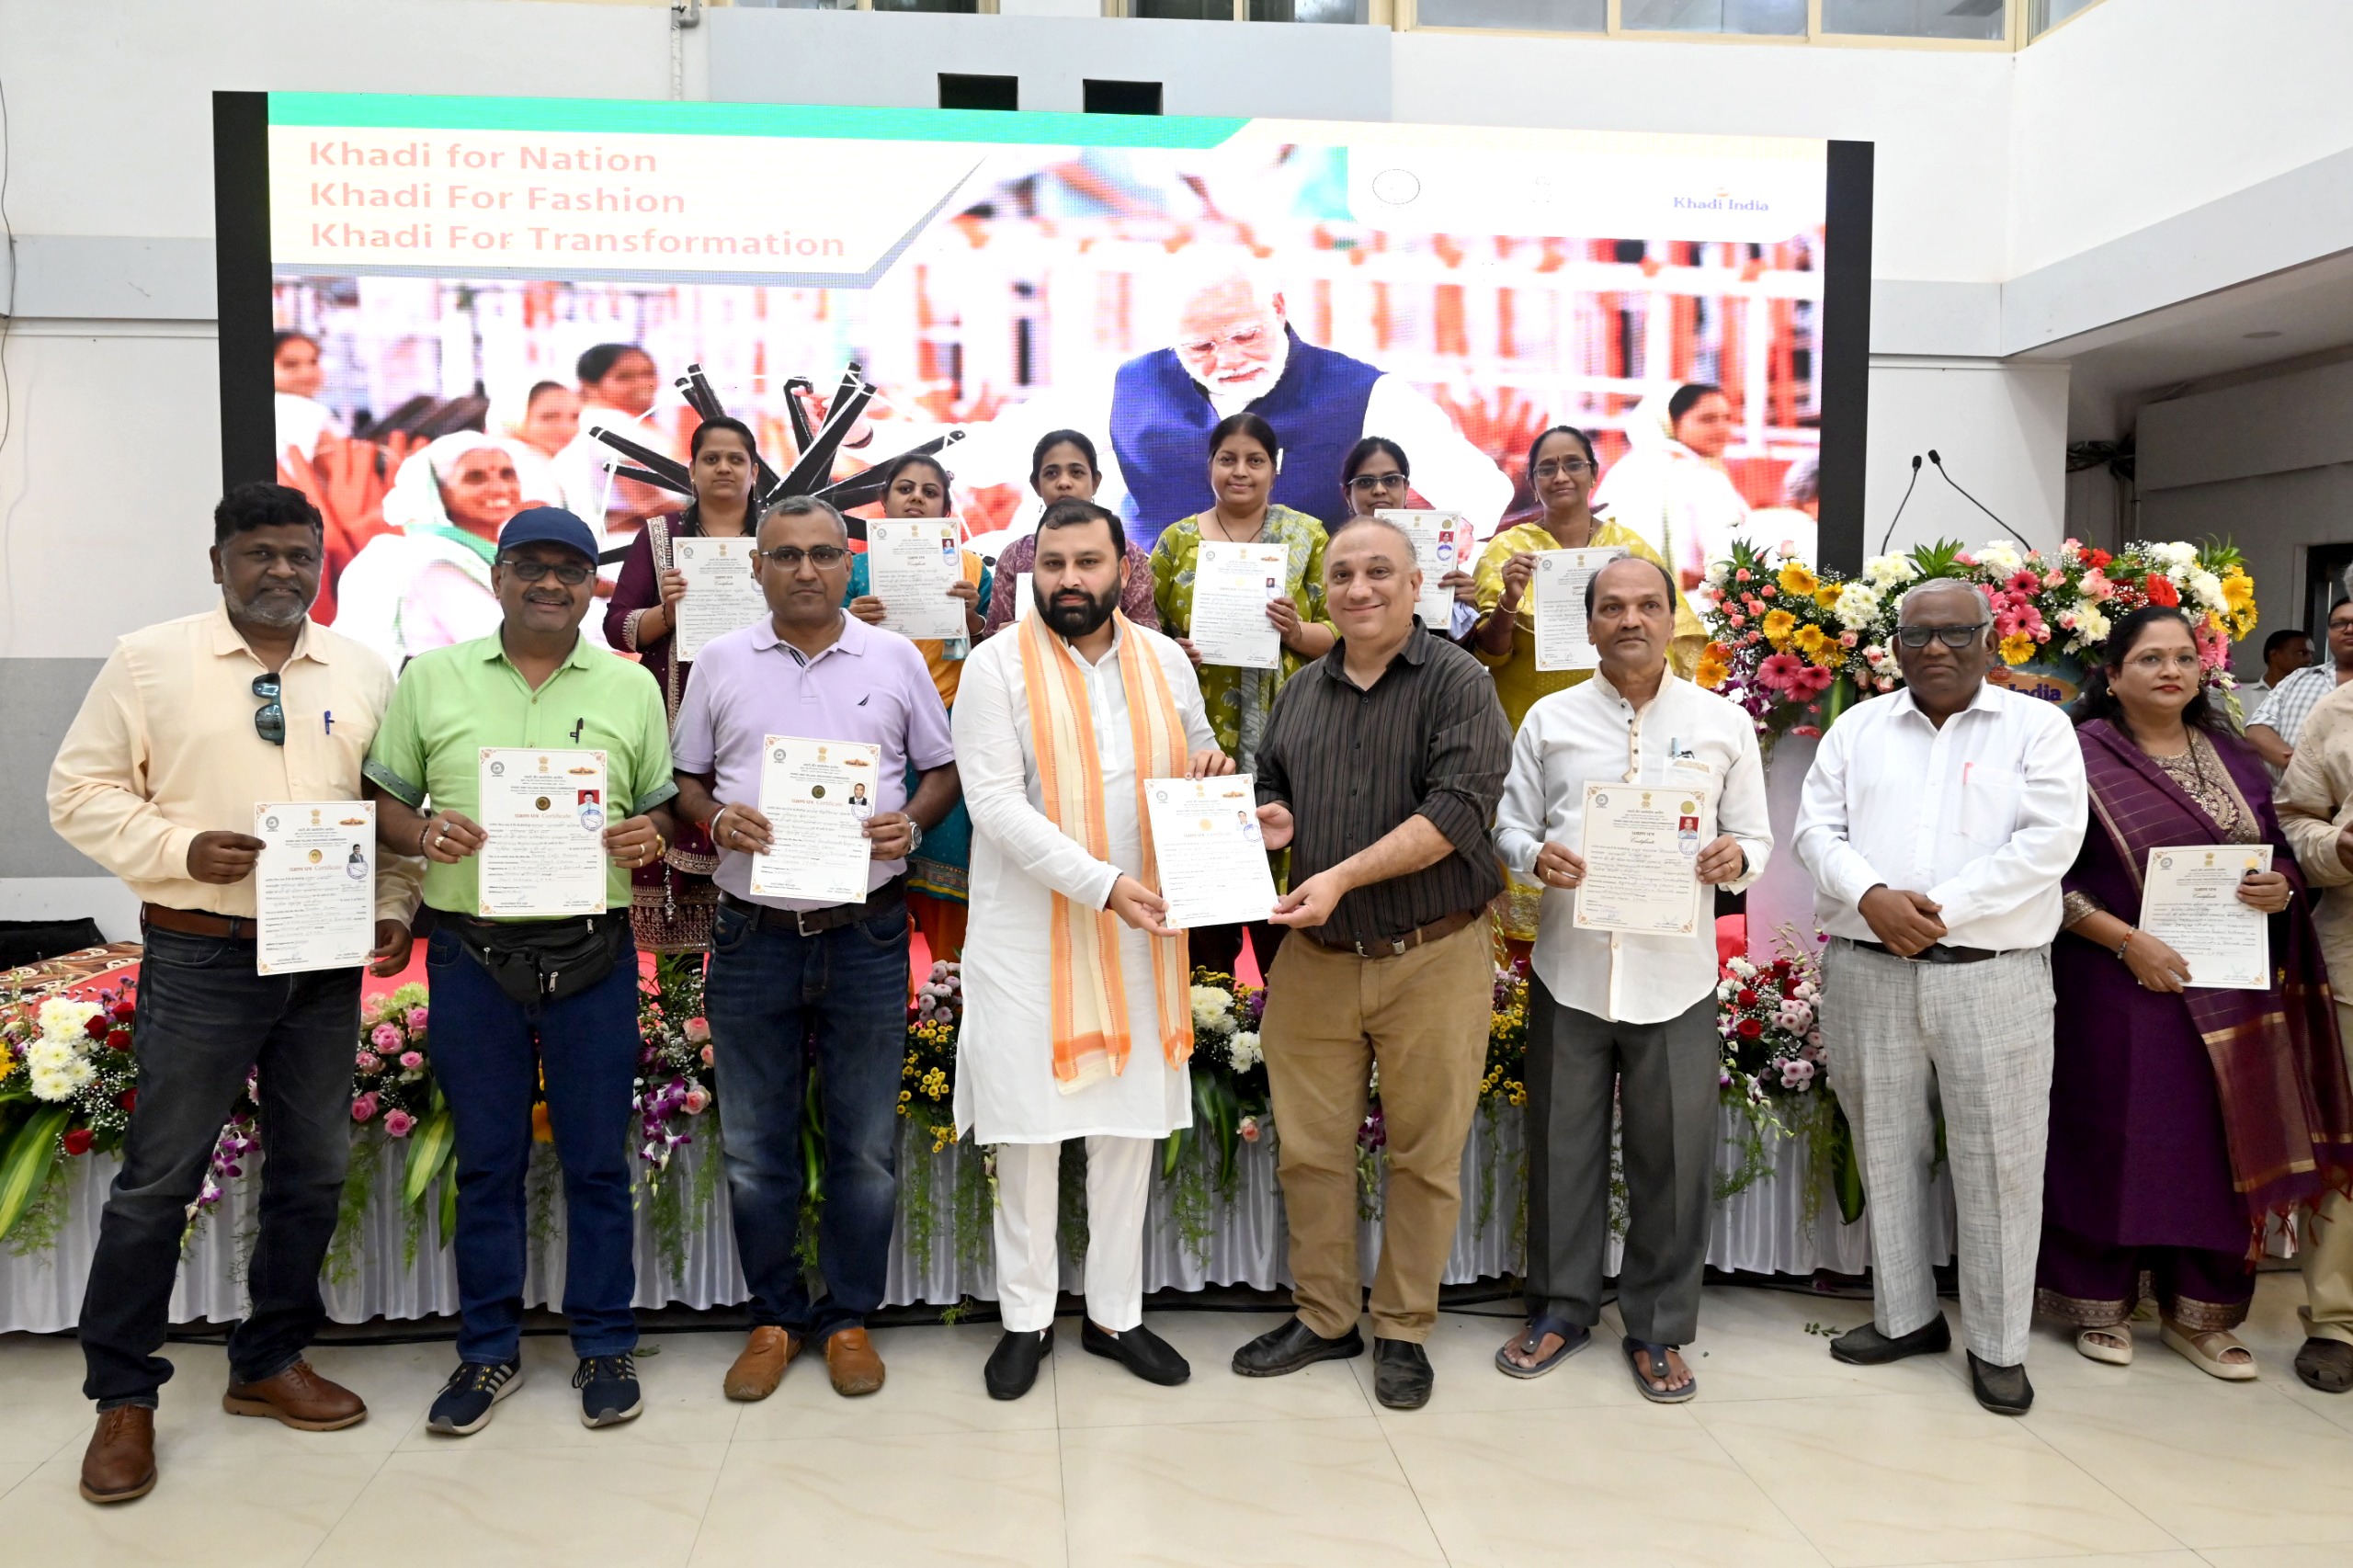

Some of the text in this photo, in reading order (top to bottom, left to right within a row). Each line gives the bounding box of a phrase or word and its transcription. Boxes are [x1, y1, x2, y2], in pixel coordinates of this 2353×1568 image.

[310, 141, 657, 173] Khadi for Nation
[311, 181, 685, 213] Khadi For Fashion
[1673, 197, 1769, 211] Khadi India
[312, 222, 845, 256] Khadi For Transformation
